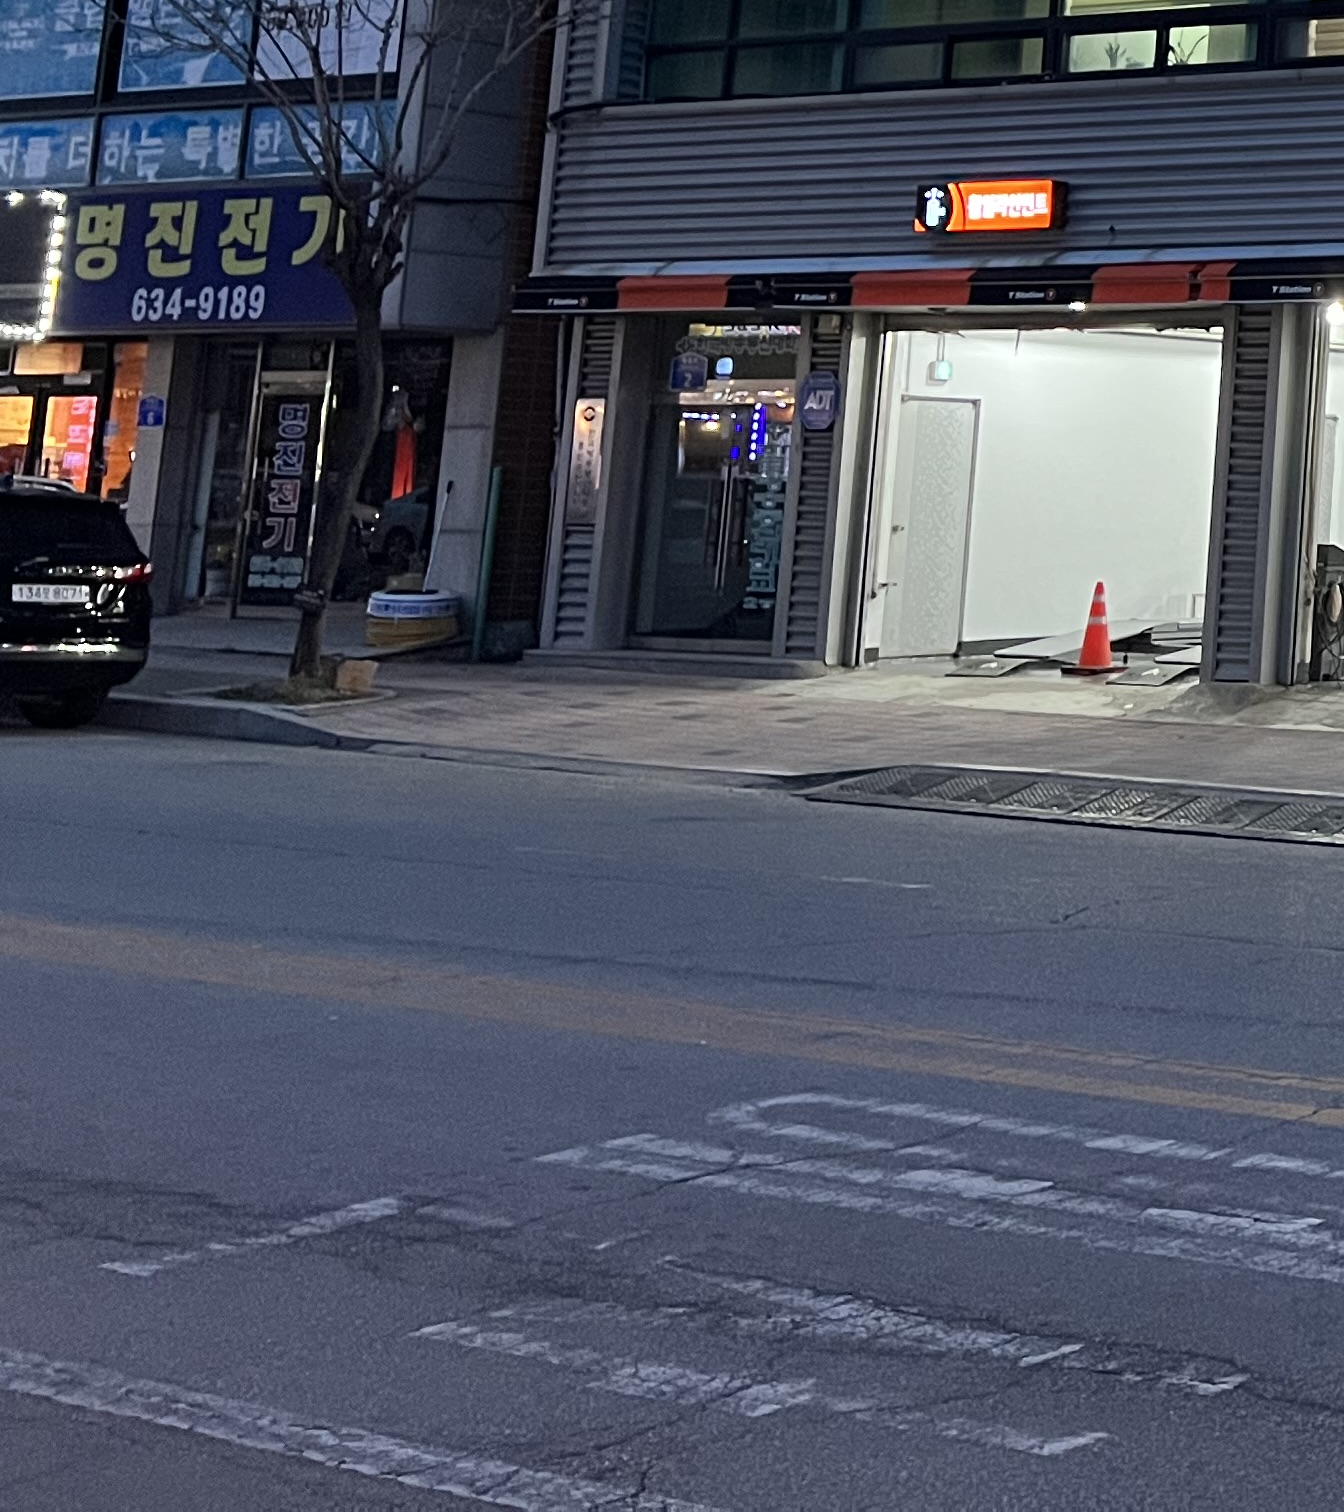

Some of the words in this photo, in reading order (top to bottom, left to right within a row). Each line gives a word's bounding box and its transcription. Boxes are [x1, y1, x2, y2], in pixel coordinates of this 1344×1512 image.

[75, 194, 346, 280] 명진전기
[131, 285, 266, 322] 634-9189
[803, 390, 834, 410] ADT
[262, 403, 310, 552] 명진전기
